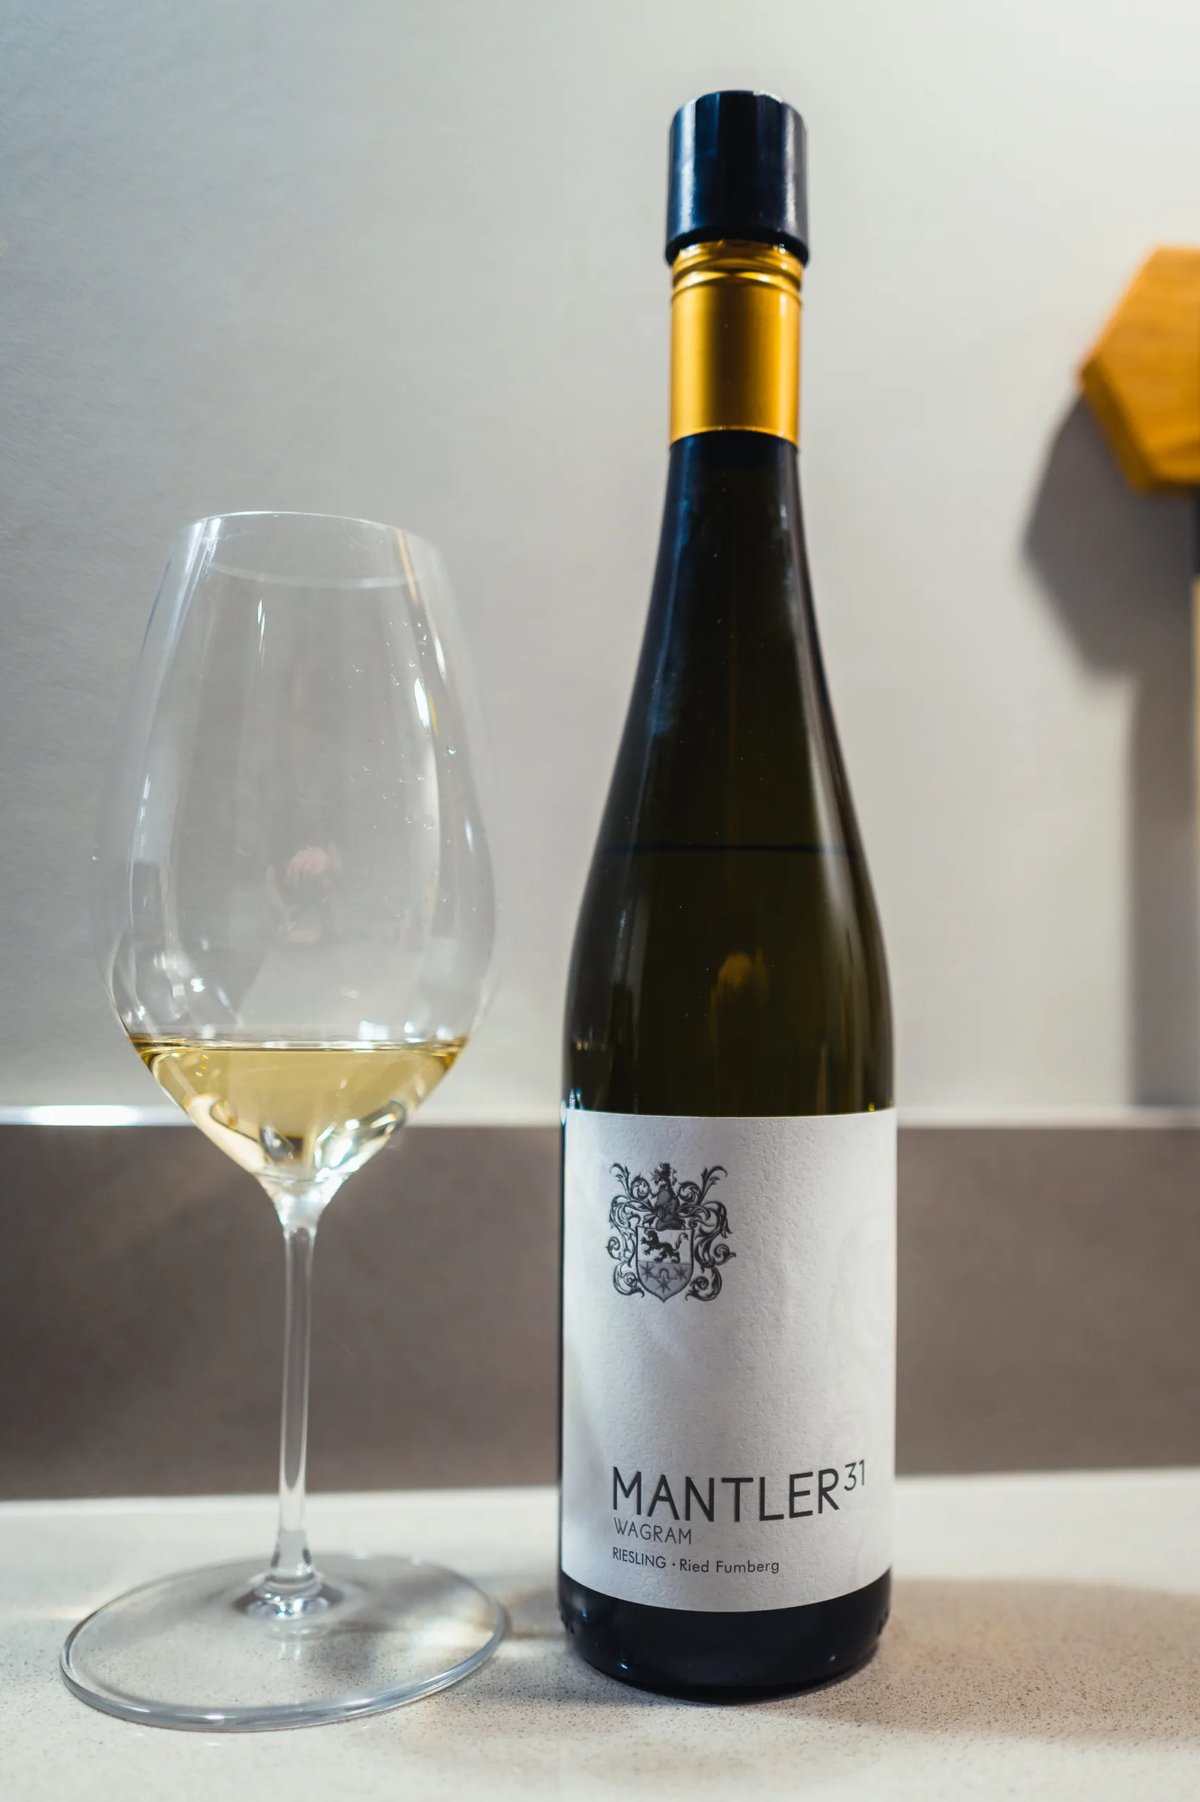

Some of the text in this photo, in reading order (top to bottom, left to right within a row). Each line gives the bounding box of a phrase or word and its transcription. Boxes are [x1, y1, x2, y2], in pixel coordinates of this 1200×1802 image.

[613, 1517, 692, 1545] WAGRAM
[612, 1546, 780, 1574] RIESLING Ried Fumberg
